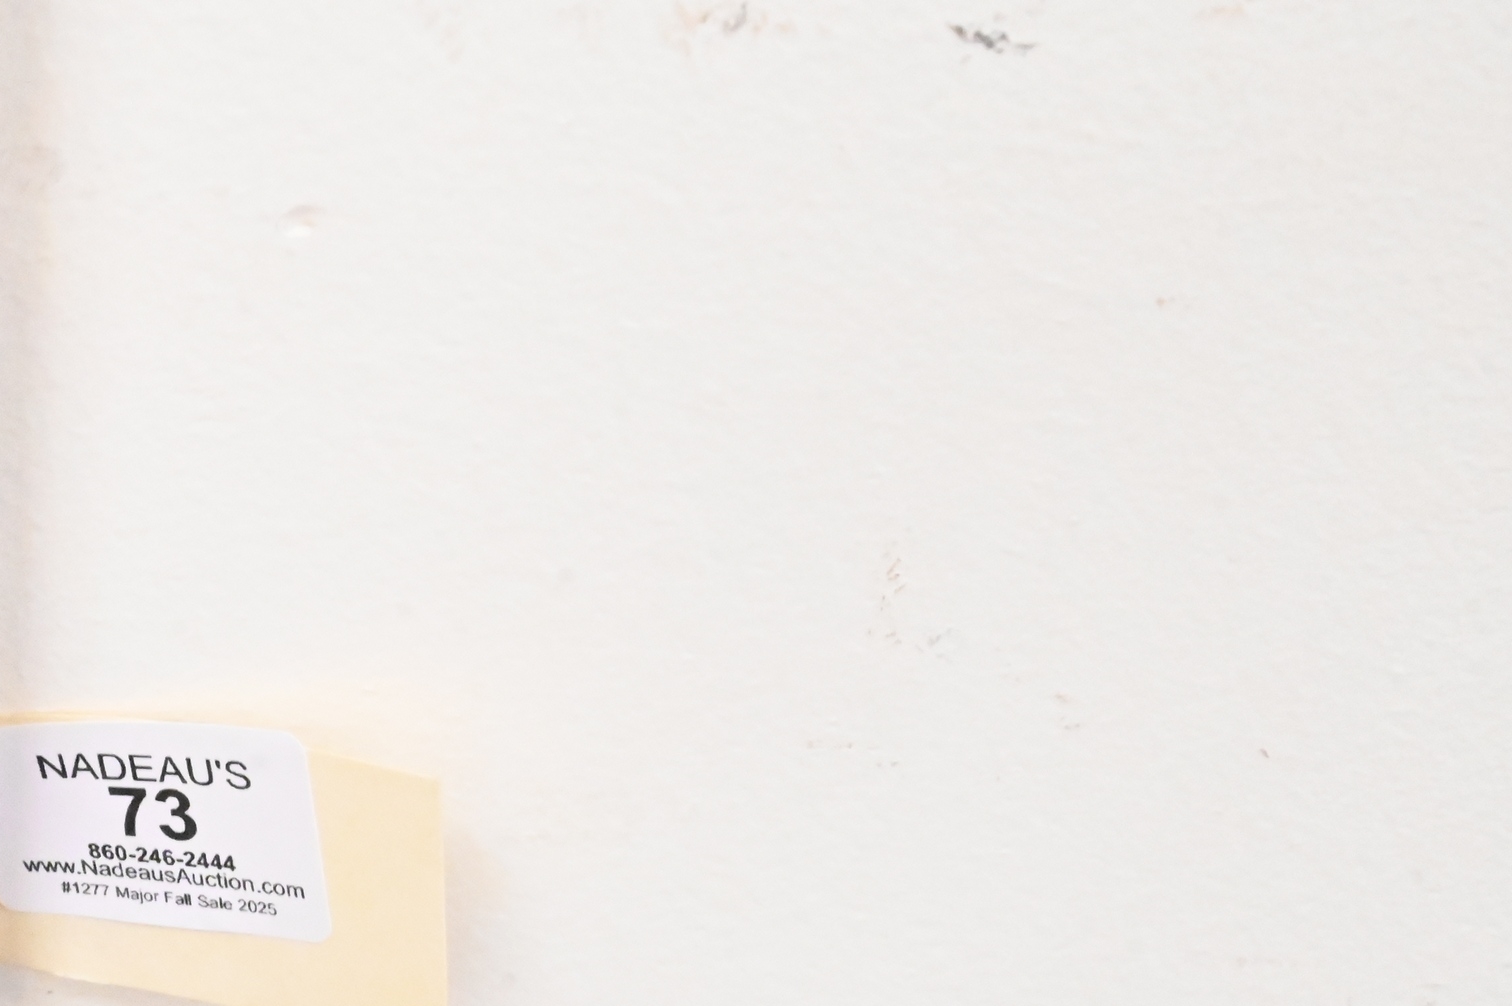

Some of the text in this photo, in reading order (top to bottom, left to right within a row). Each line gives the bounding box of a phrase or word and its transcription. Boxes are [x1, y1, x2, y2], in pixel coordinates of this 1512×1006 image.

[36, 753, 252, 789] NADEAU'S
[107, 786, 197, 841] 73
[88, 843, 236, 871] 860-246-2444
[23, 859, 305, 899] www.NadeausAuction.com
[62, 881, 277, 916] #1277 Major Fall Sale 2025
